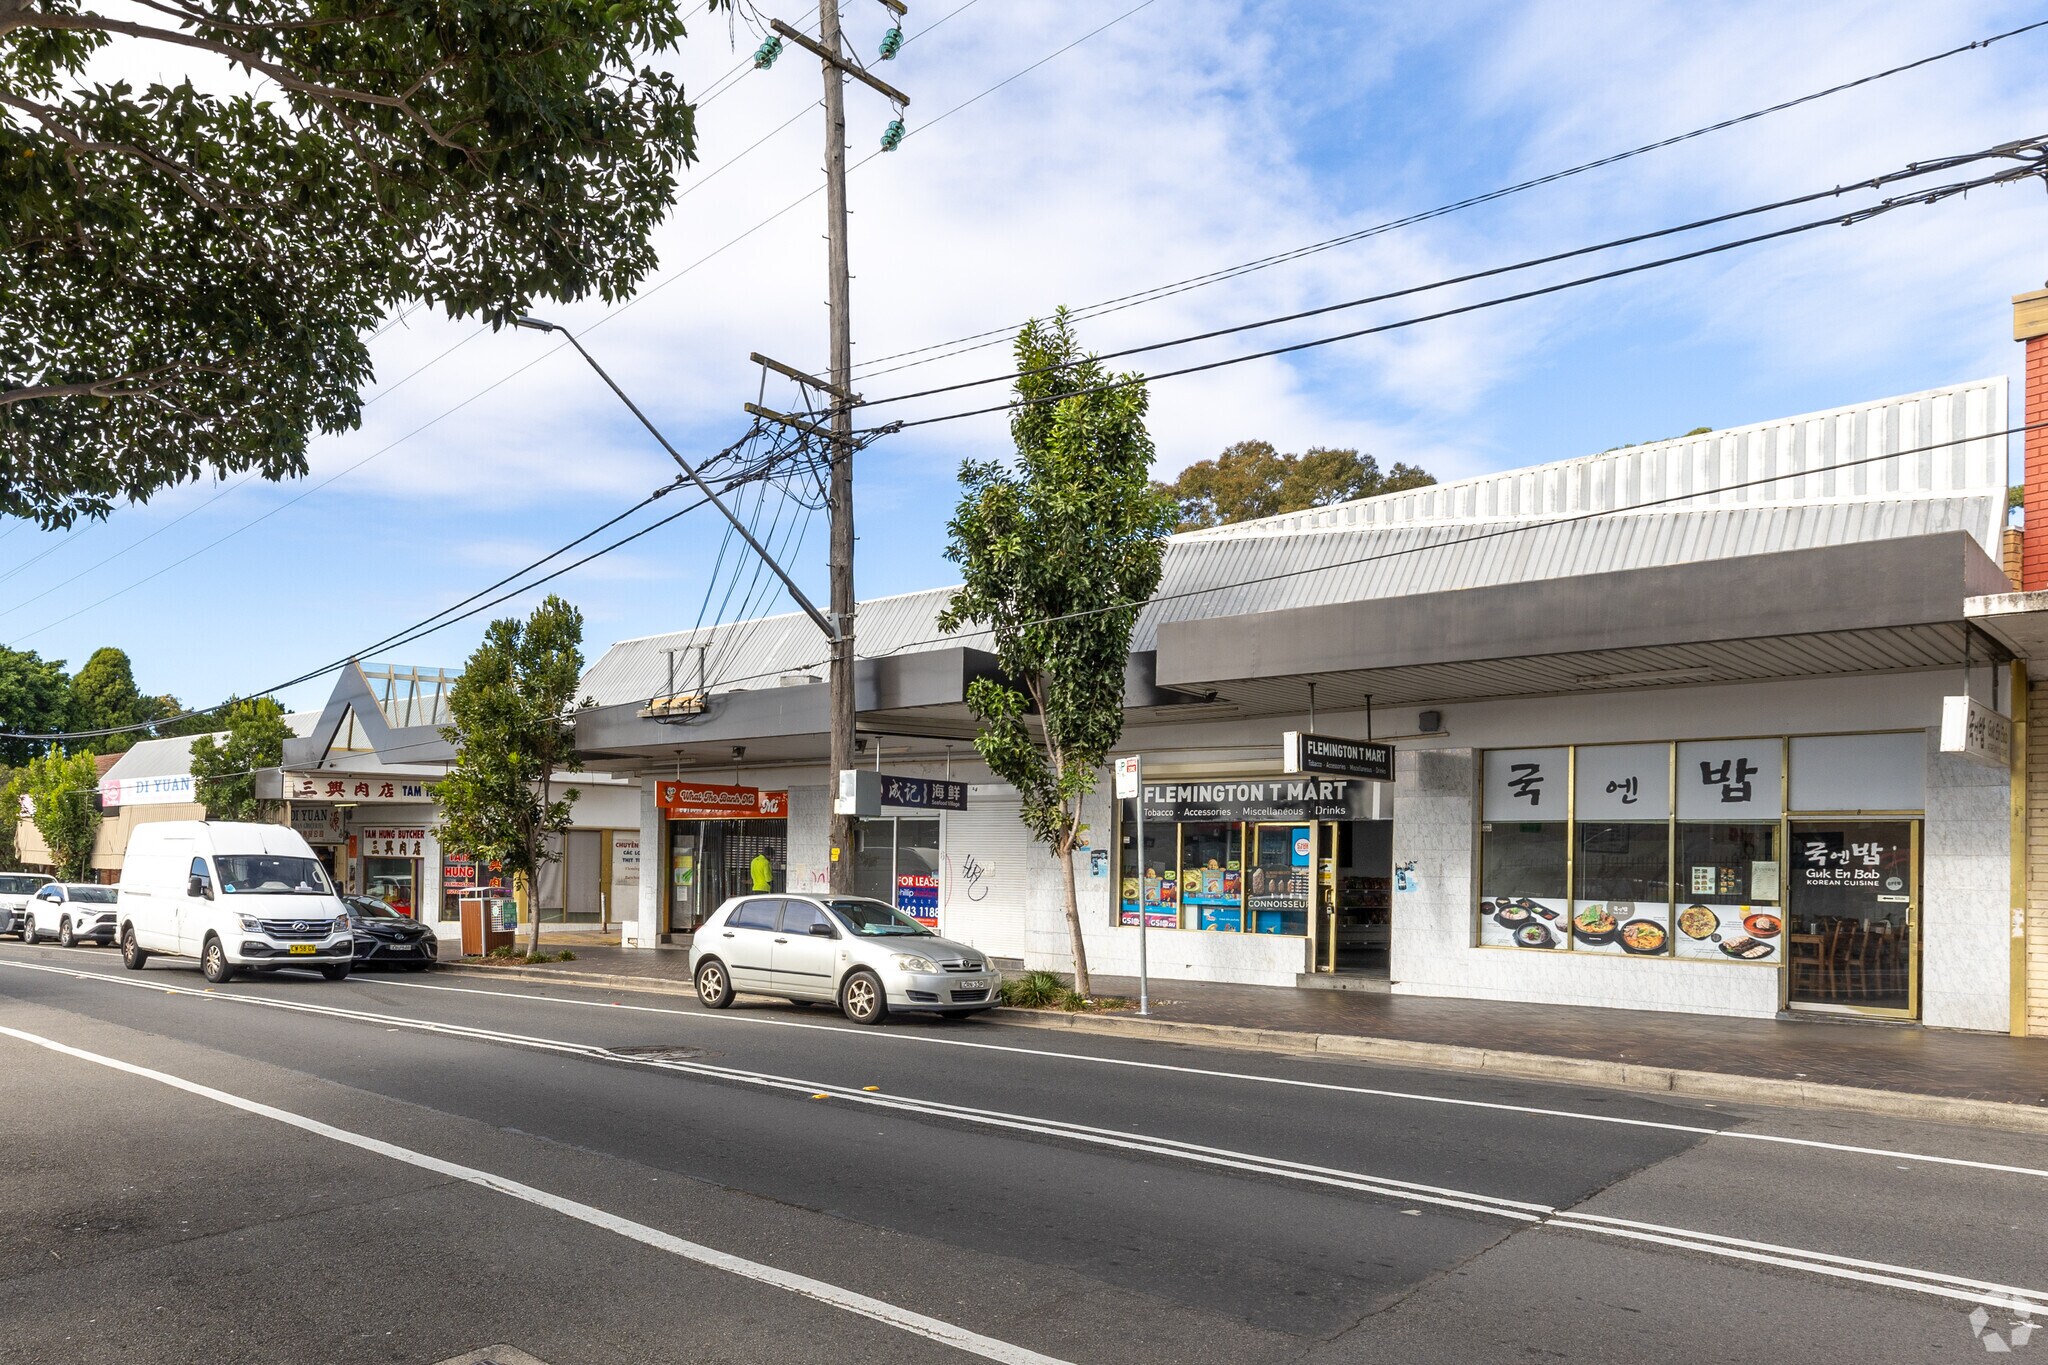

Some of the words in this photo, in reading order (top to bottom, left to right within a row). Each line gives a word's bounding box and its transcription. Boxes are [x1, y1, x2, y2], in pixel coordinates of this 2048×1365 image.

[1307, 741, 1358, 759] FLEMINGTON
[1359, 747, 1364, 760] T
[1366, 748, 1386, 763] MART
[136, 780, 149, 793] DI
[154, 777, 190, 792] YUAN
[1508, 763, 1544, 805] 국
[1606, 776, 1638, 804] 엔
[1700, 758, 1758, 803] 밥
[300, 780, 394, 798] 三興肉店
[402, 785, 421, 797] TAM
[932, 784, 960, 801] 海鲜
[1144, 784, 1264, 803] FLEMINGTON
[1269, 784, 1282, 801] T
[1287, 781, 1347, 801] MART
[680, 790, 702, 803] What
[702, 791, 718, 804] The
[301, 809, 327, 821] YUAN
[1144, 808, 1174, 817] Tobacco
[1184, 807, 1231, 817] Accessories
[1243, 806, 1304, 816] Miscellaneous
[1315, 805, 1346, 815] Drinks
[364, 830, 376, 838] TAM
[378, 830, 395, 839] HUNG
[397, 829, 425, 839] BUTCHER
[371, 840, 421, 856] 三興肉店
[1804, 842, 1884, 866] 국엔밥
[444, 866, 474, 877] HUNG
[1806, 868, 1831, 878] Guk
[1835, 868, 1850, 878] En
[1854, 869, 1880, 879] Bab
[916, 877, 939, 887] LEASE
[919, 907, 939, 918] 1188
